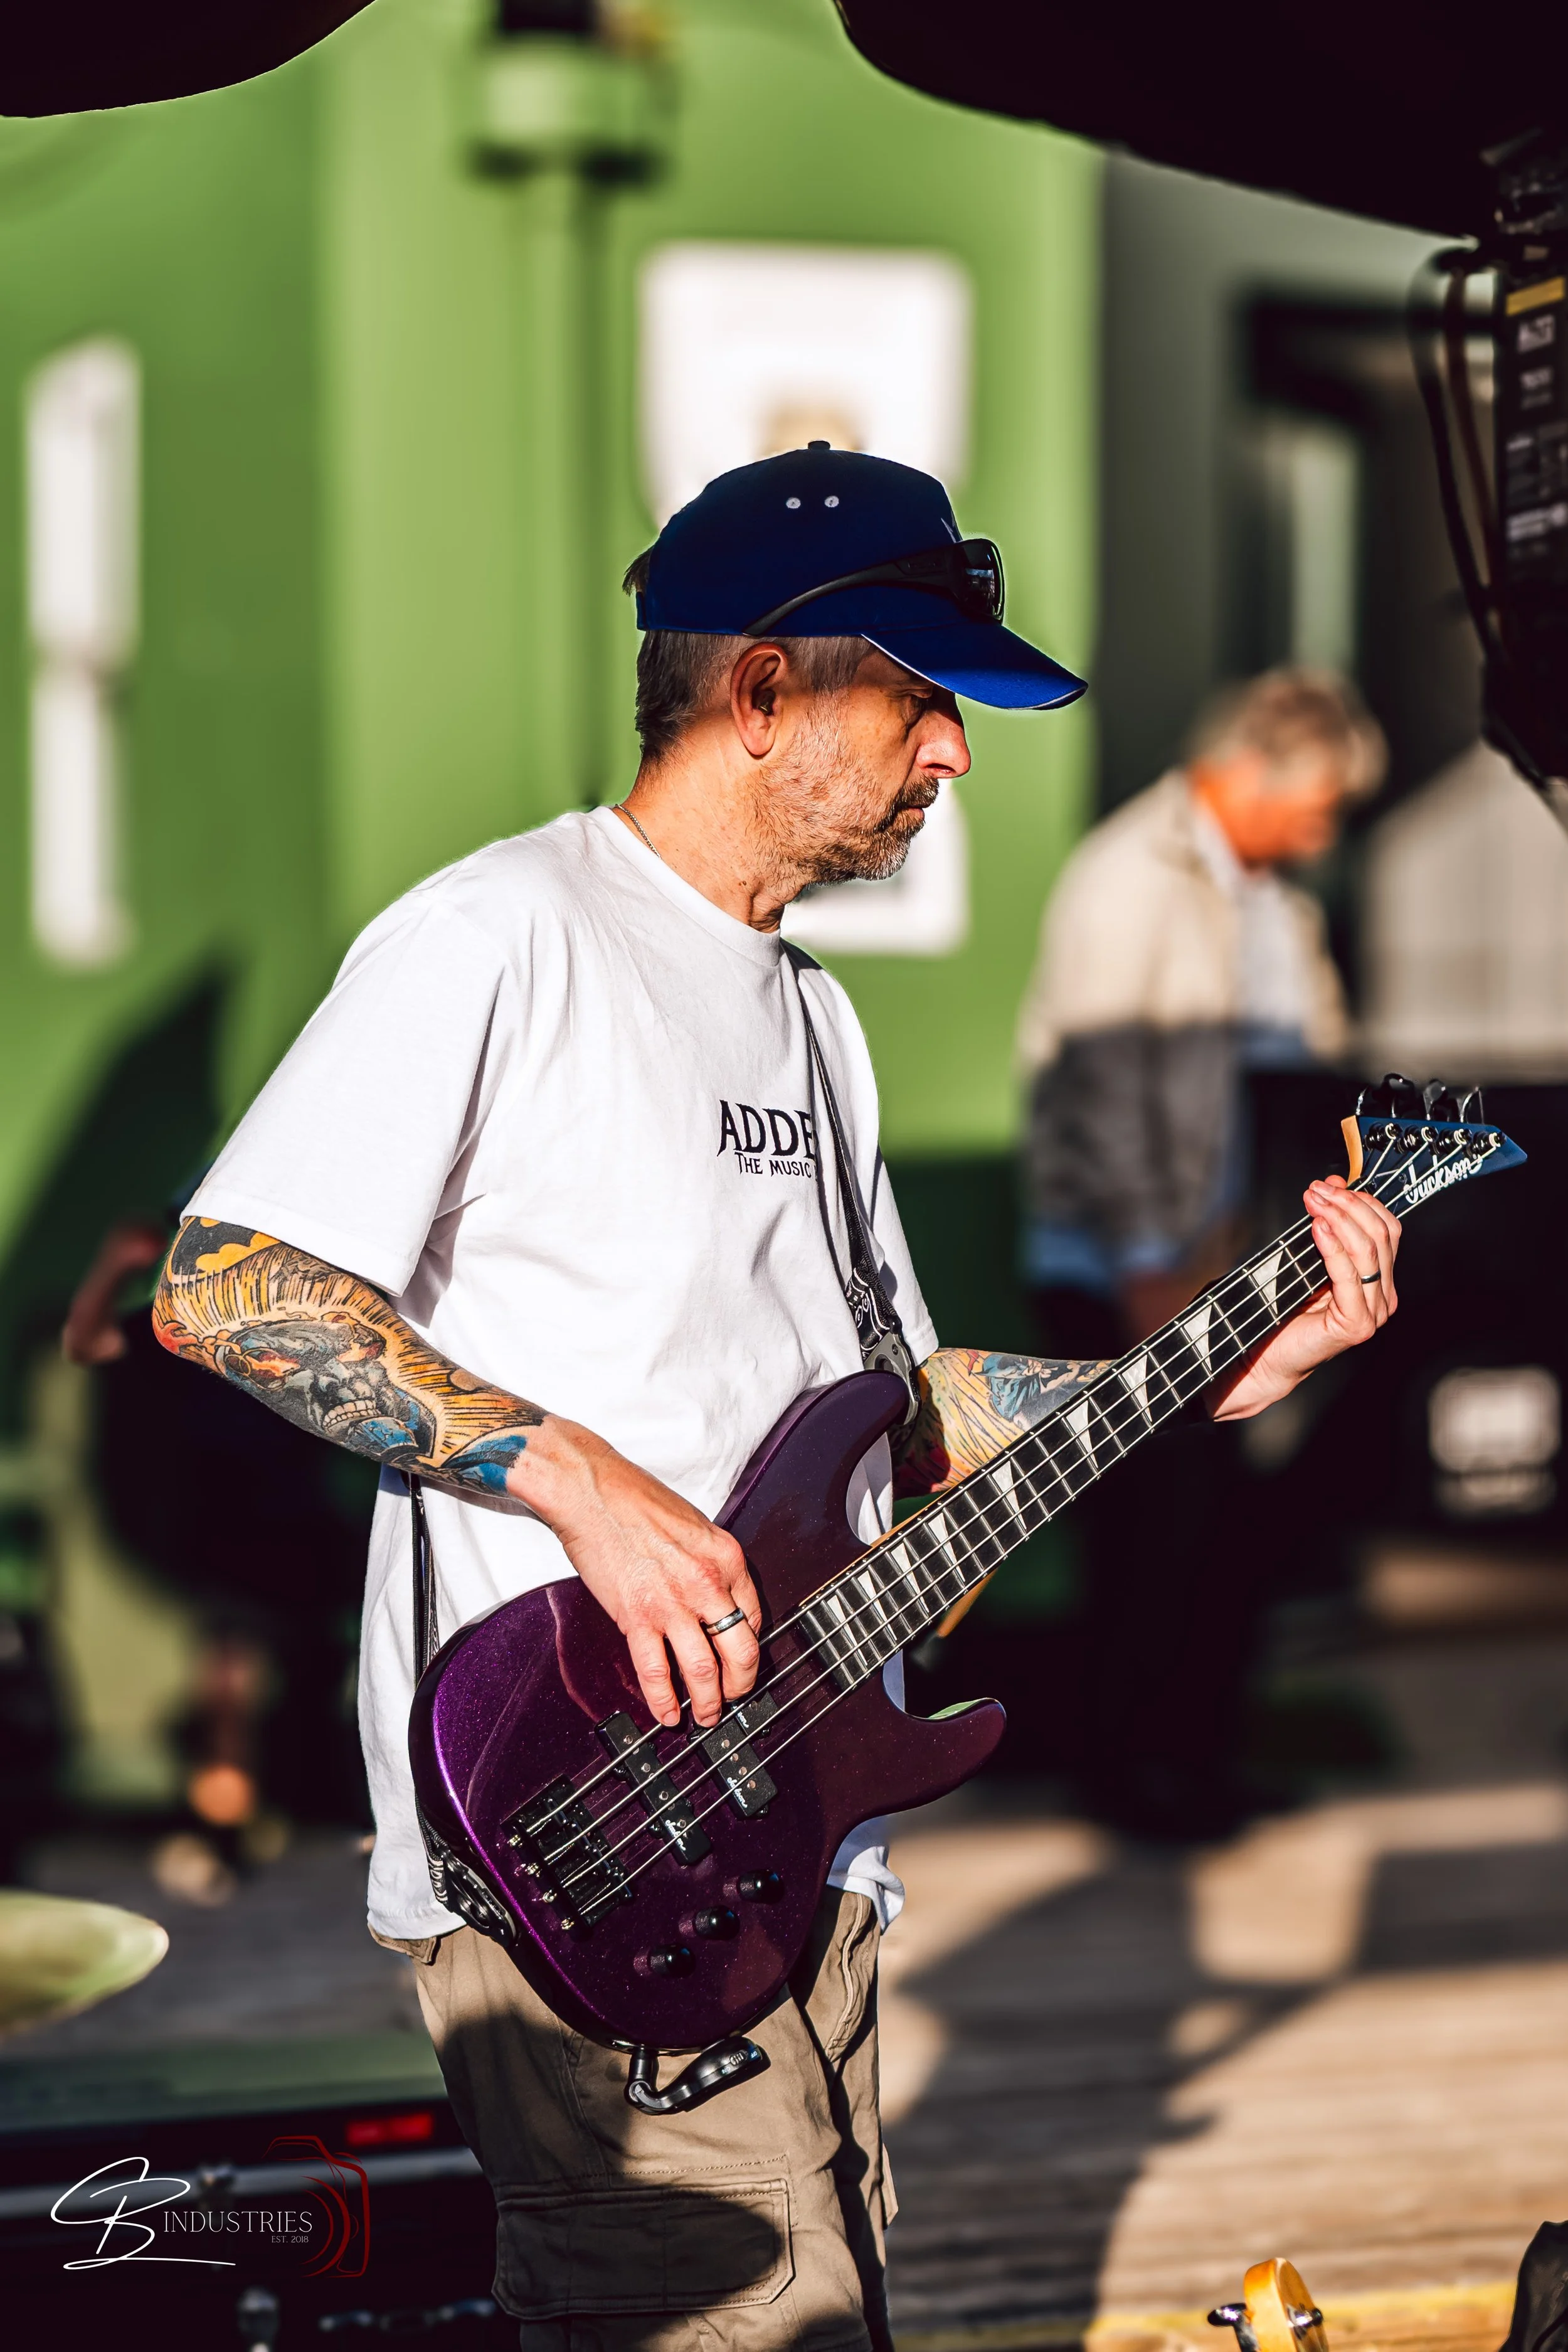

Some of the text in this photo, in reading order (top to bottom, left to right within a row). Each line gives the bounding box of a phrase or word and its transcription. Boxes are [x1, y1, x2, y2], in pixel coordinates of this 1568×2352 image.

[734, 1152, 763, 1174] THE
[769, 1159, 812, 1178] MUSIC
[1403, 1153, 1483, 1205] Jackson
[726, 1777, 748, 1808] Jakson
[665, 1819, 686, 1851] Jackon
